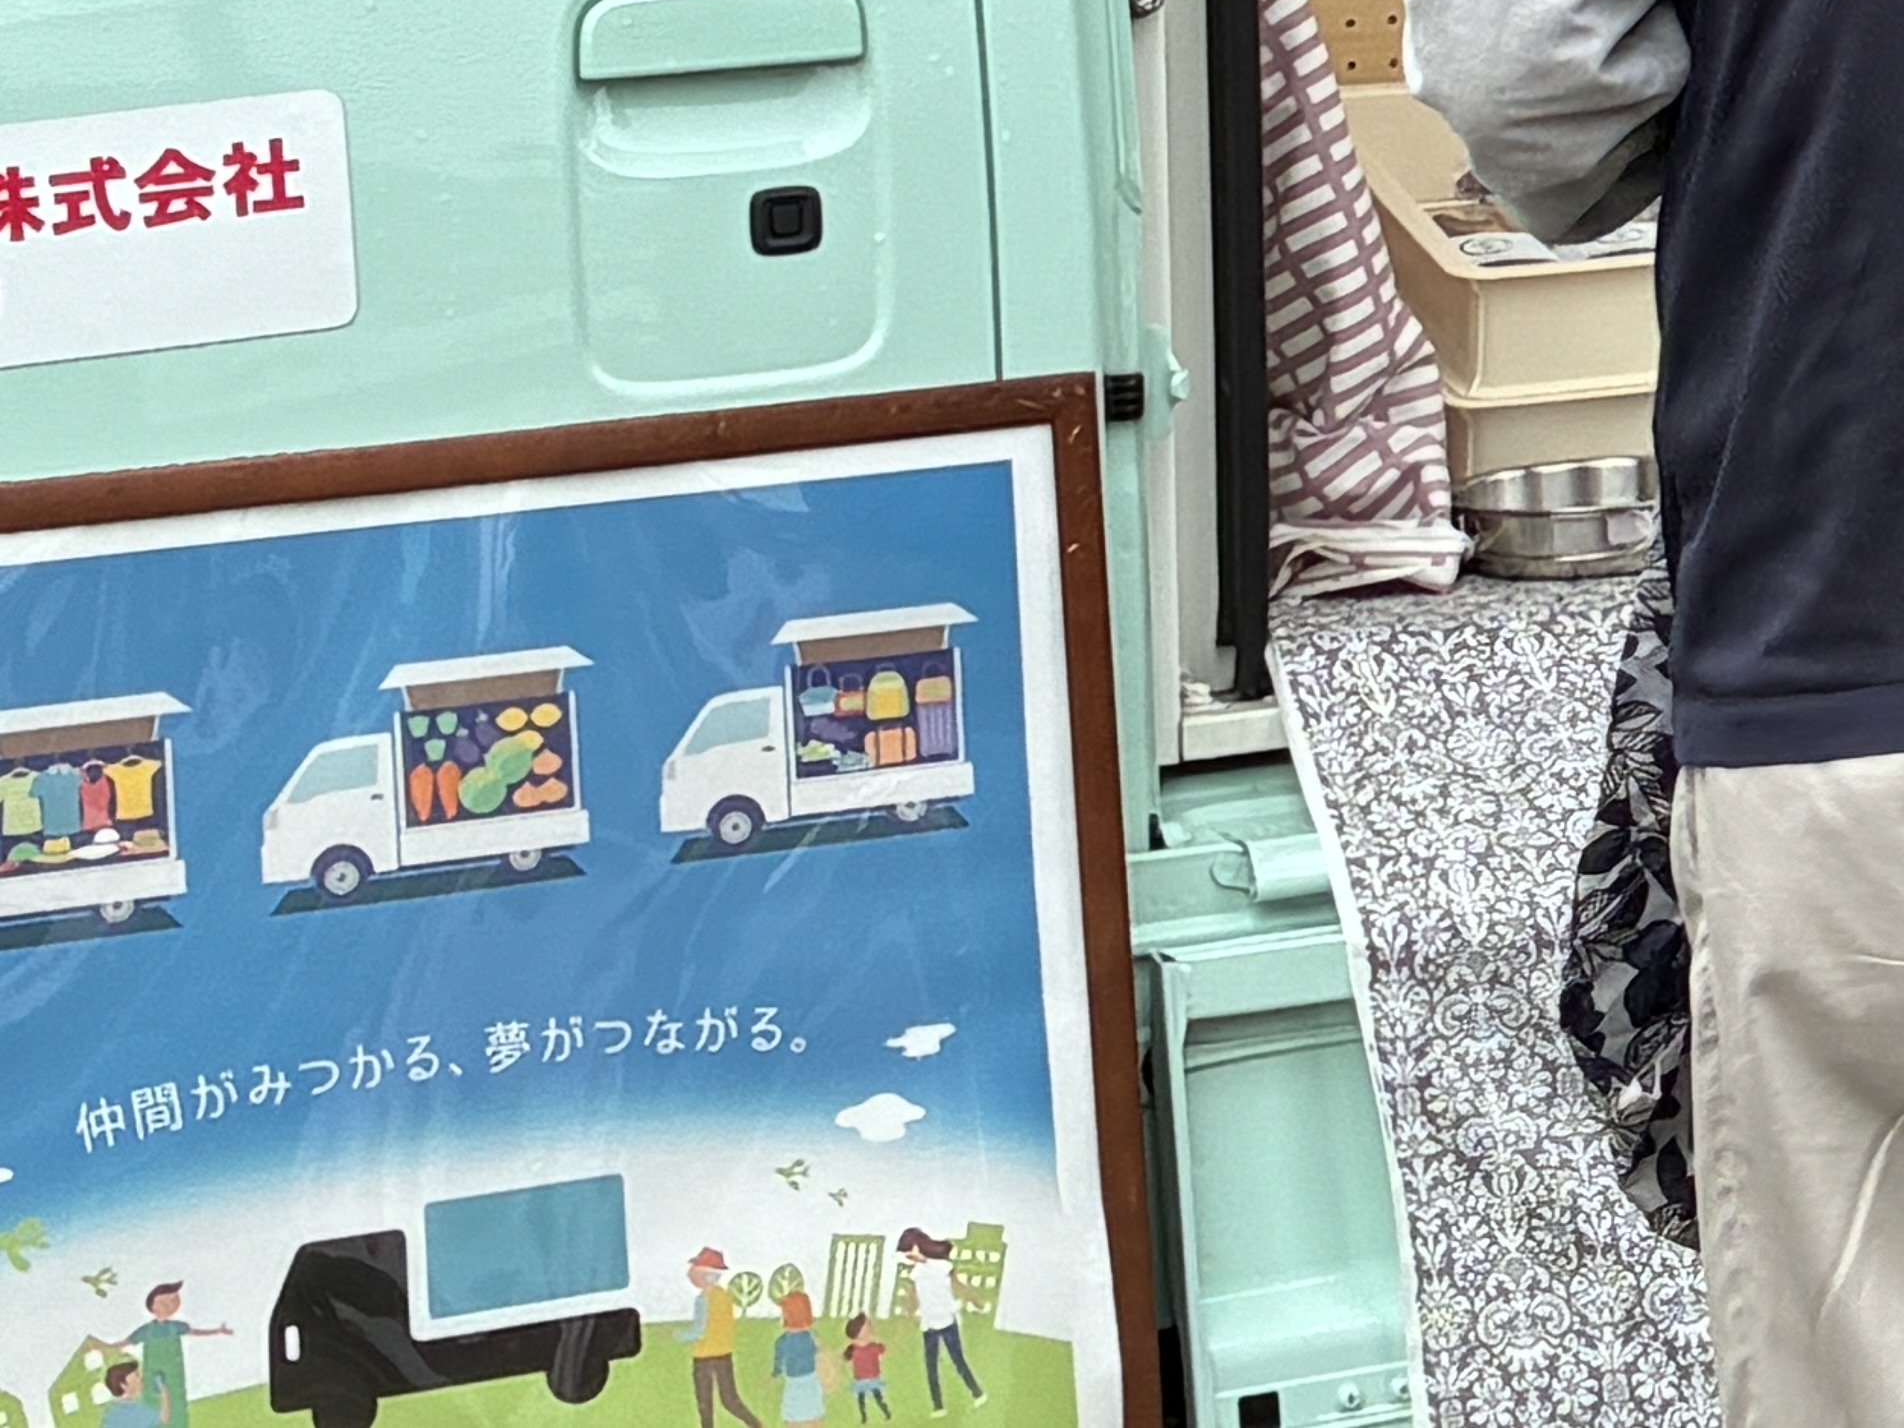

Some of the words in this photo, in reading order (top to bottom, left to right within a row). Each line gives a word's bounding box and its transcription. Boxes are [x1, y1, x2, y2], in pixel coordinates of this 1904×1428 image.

[0, 138, 305, 242] 株式会社
[75, 1006, 807, 1154] 仲間がみつかる、夢がつながる。
